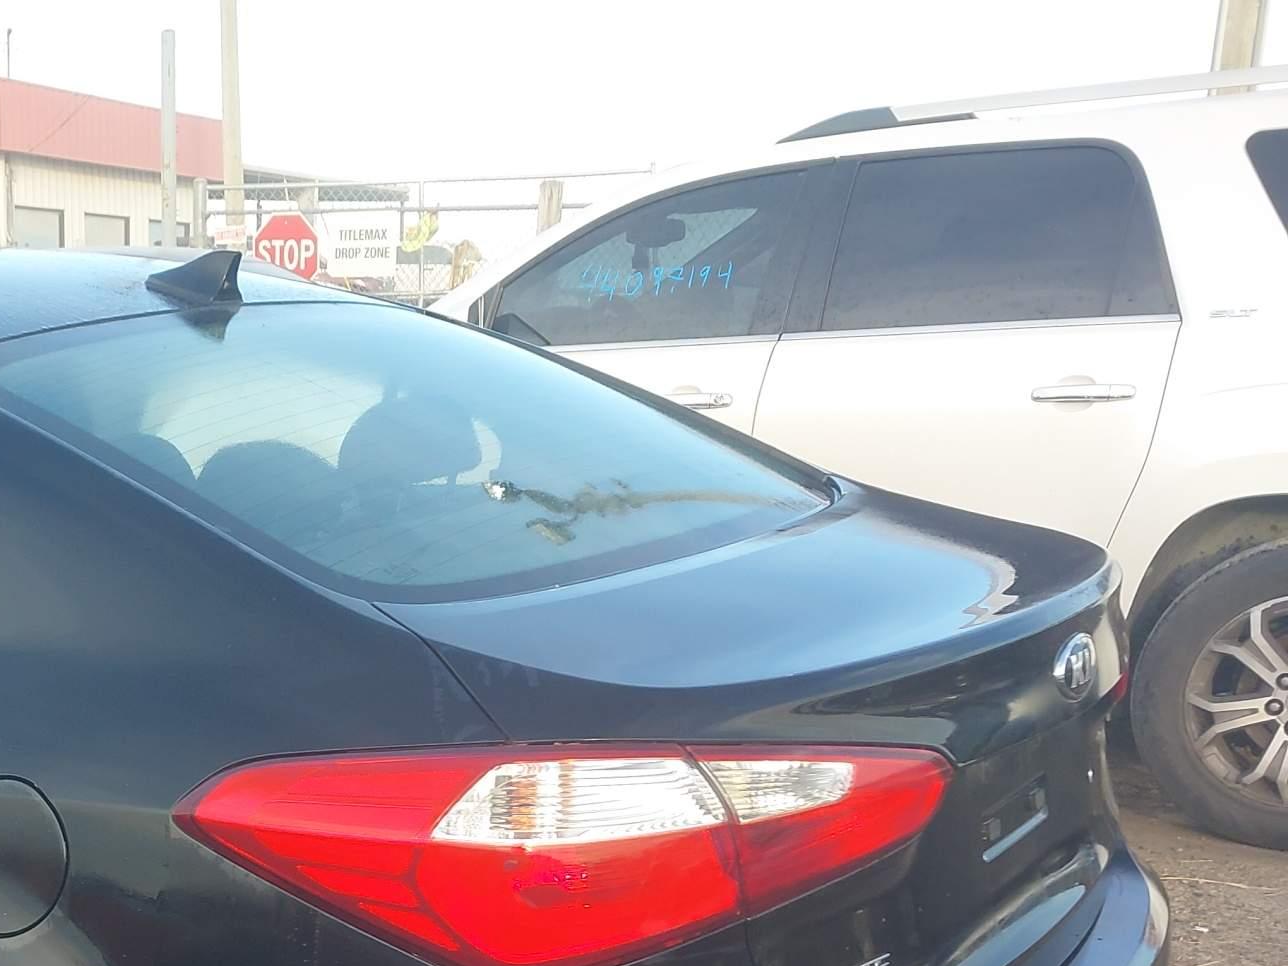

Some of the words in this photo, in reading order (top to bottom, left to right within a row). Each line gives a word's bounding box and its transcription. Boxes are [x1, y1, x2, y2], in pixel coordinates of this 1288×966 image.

[339, 228, 388, 242] TITLEMAX
[258, 239, 316, 271] STOP
[335, 247, 361, 260] DROP
[364, 246, 390, 260] ZONE
